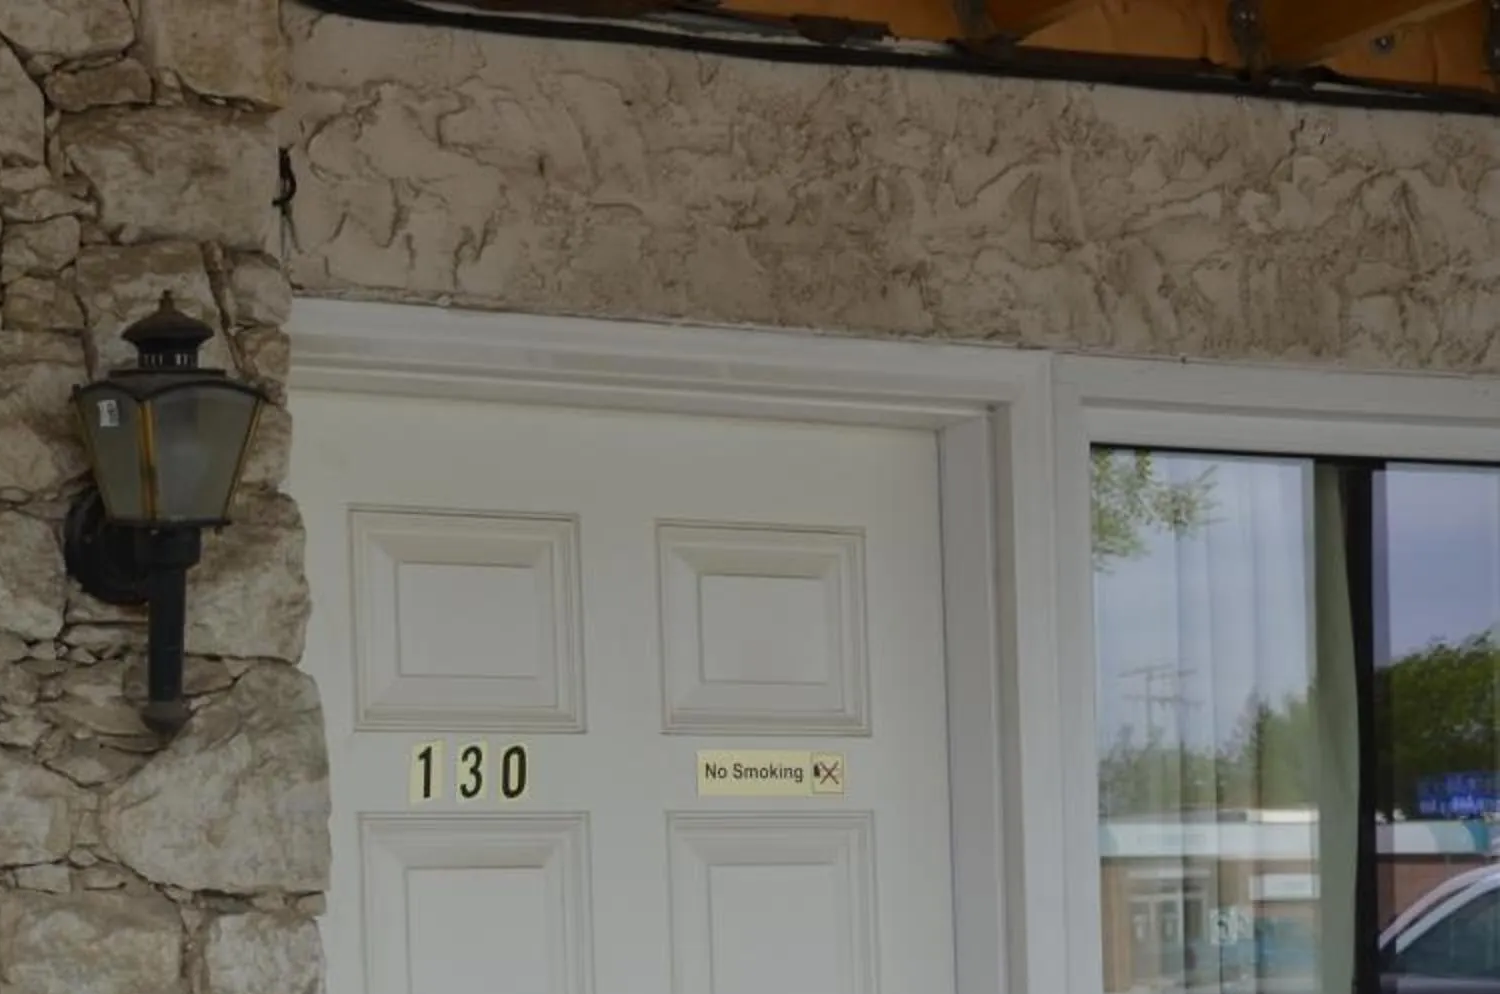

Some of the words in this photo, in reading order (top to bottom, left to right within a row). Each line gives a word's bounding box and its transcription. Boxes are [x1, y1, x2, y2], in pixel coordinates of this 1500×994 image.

[417, 745, 528, 799] 130
[704, 762, 728, 780] No
[732, 761, 805, 784] Smoking
